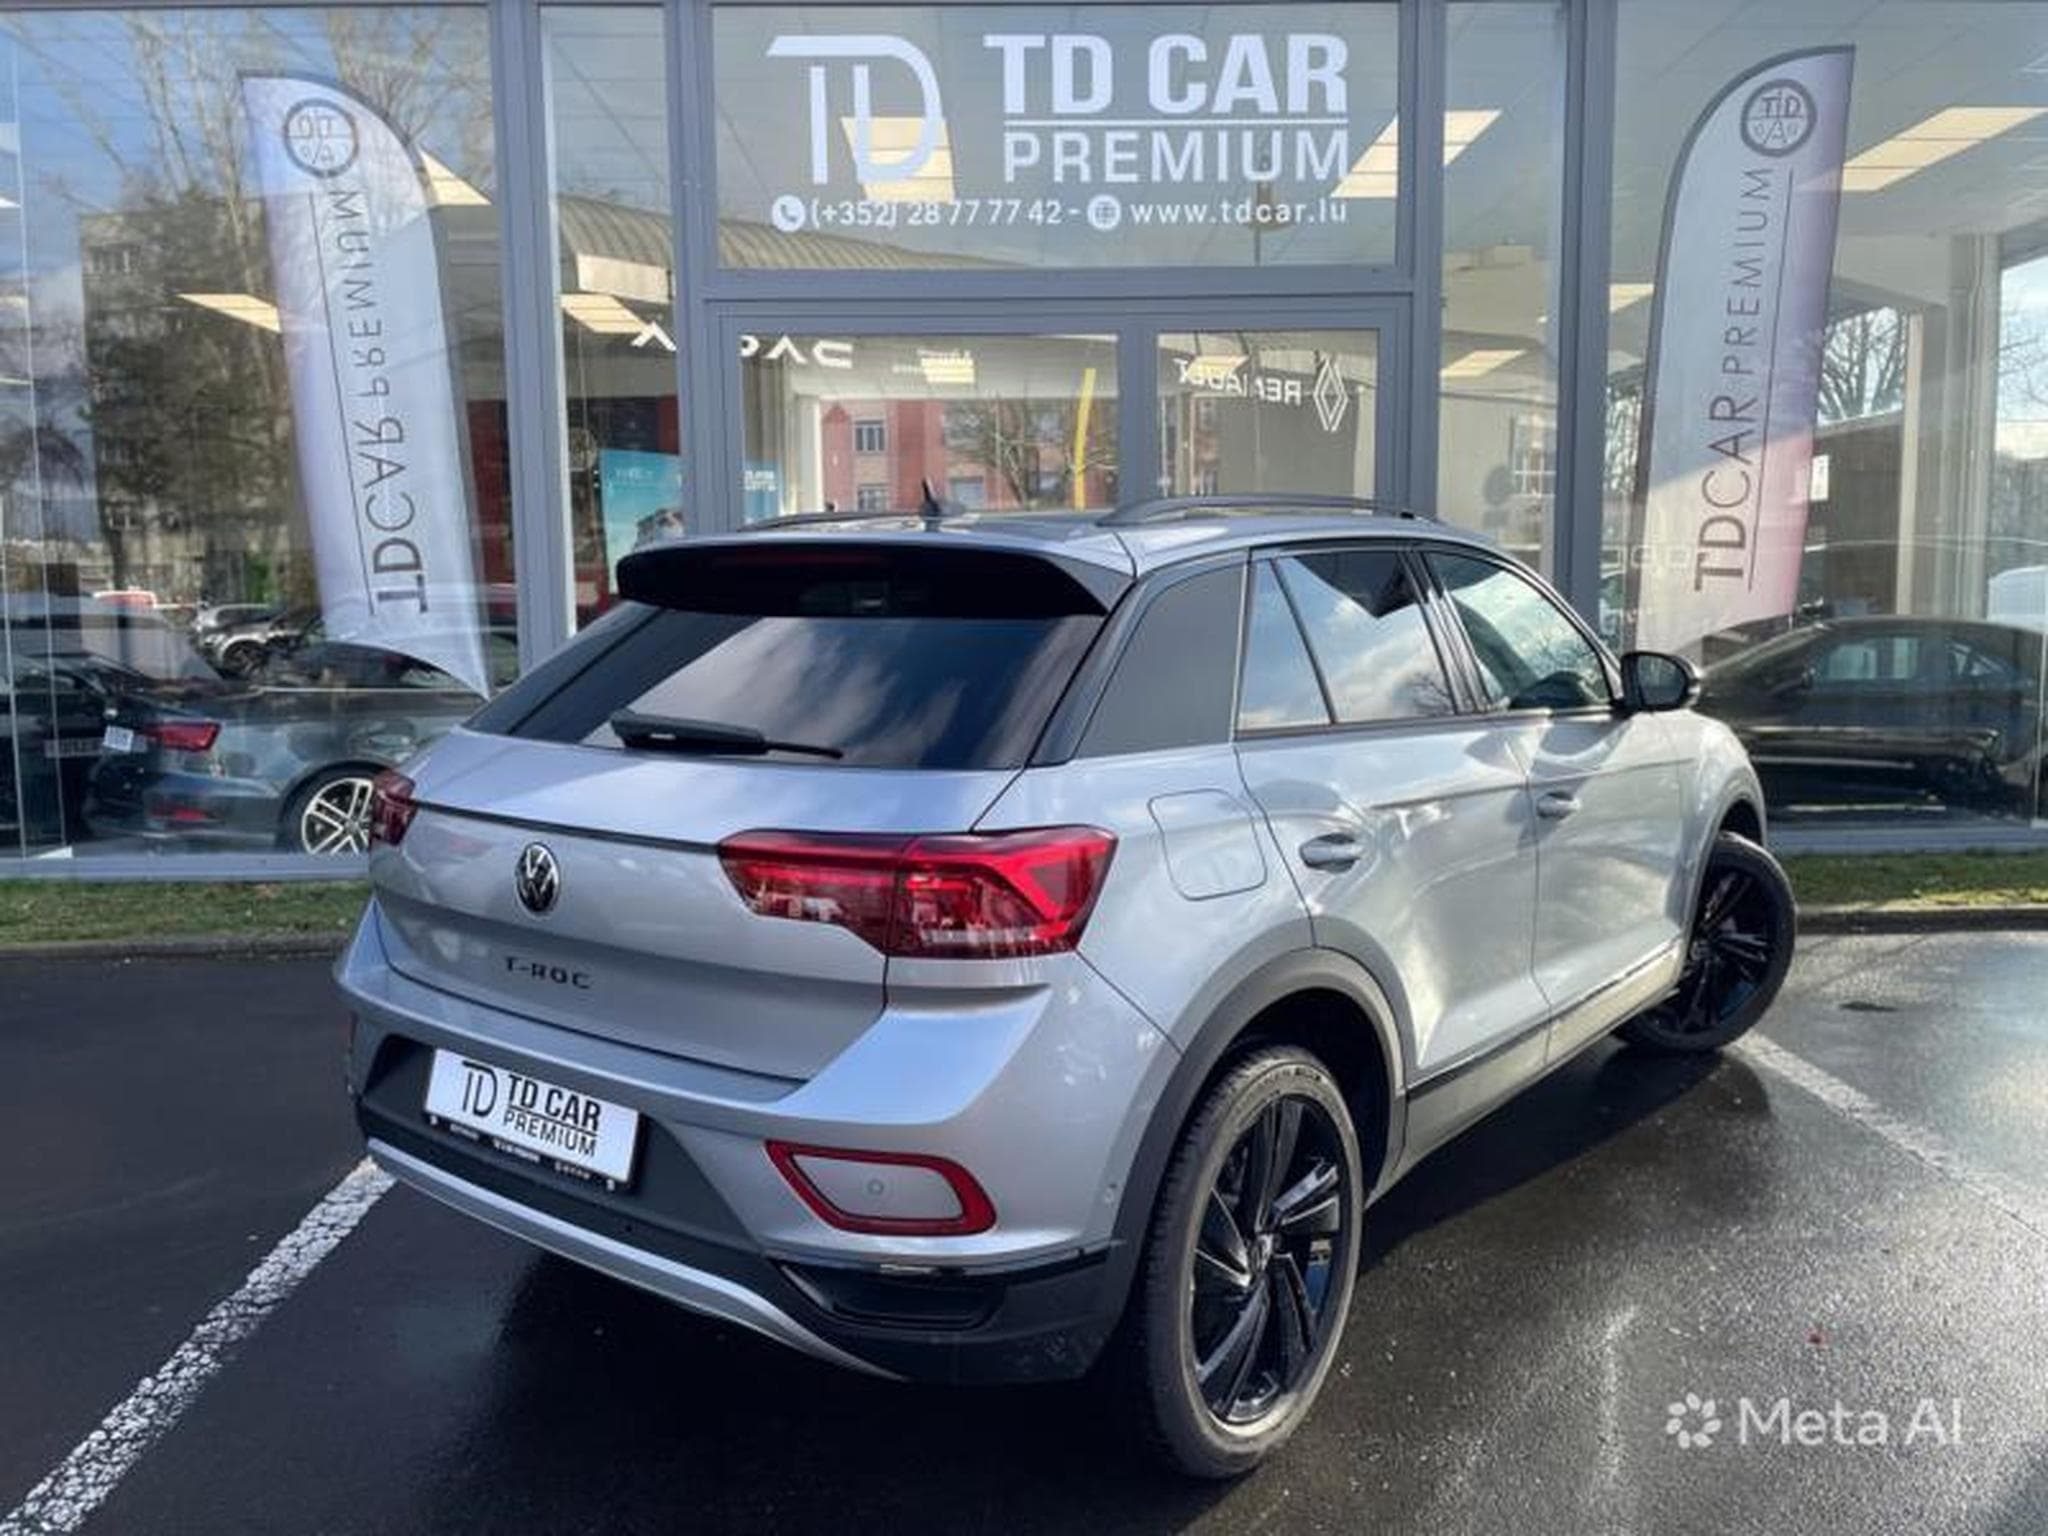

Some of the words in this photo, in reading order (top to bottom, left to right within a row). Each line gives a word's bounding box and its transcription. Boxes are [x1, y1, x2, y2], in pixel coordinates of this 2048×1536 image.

[983, 34, 1113, 114] TD
[1148, 34, 1349, 114] CAR
[1003, 131, 1349, 183] PREMIUM
[811, 199, 897, 229] (+352)
[907, 203, 942, 226] 28
[949, 201, 981, 226] 77
[990, 201, 1022, 226] 77
[1028, 202, 1061, 225] 42
[1130, 199, 1348, 225] www.tdcar.lu
[1723, 168, 1773, 375] PREMIUM
[505, 955, 591, 990] T-ROC
[507, 1074, 538, 1110] TD
[546, 1086, 601, 1132] CAR
[503, 1108, 598, 1157] PREMIUM
